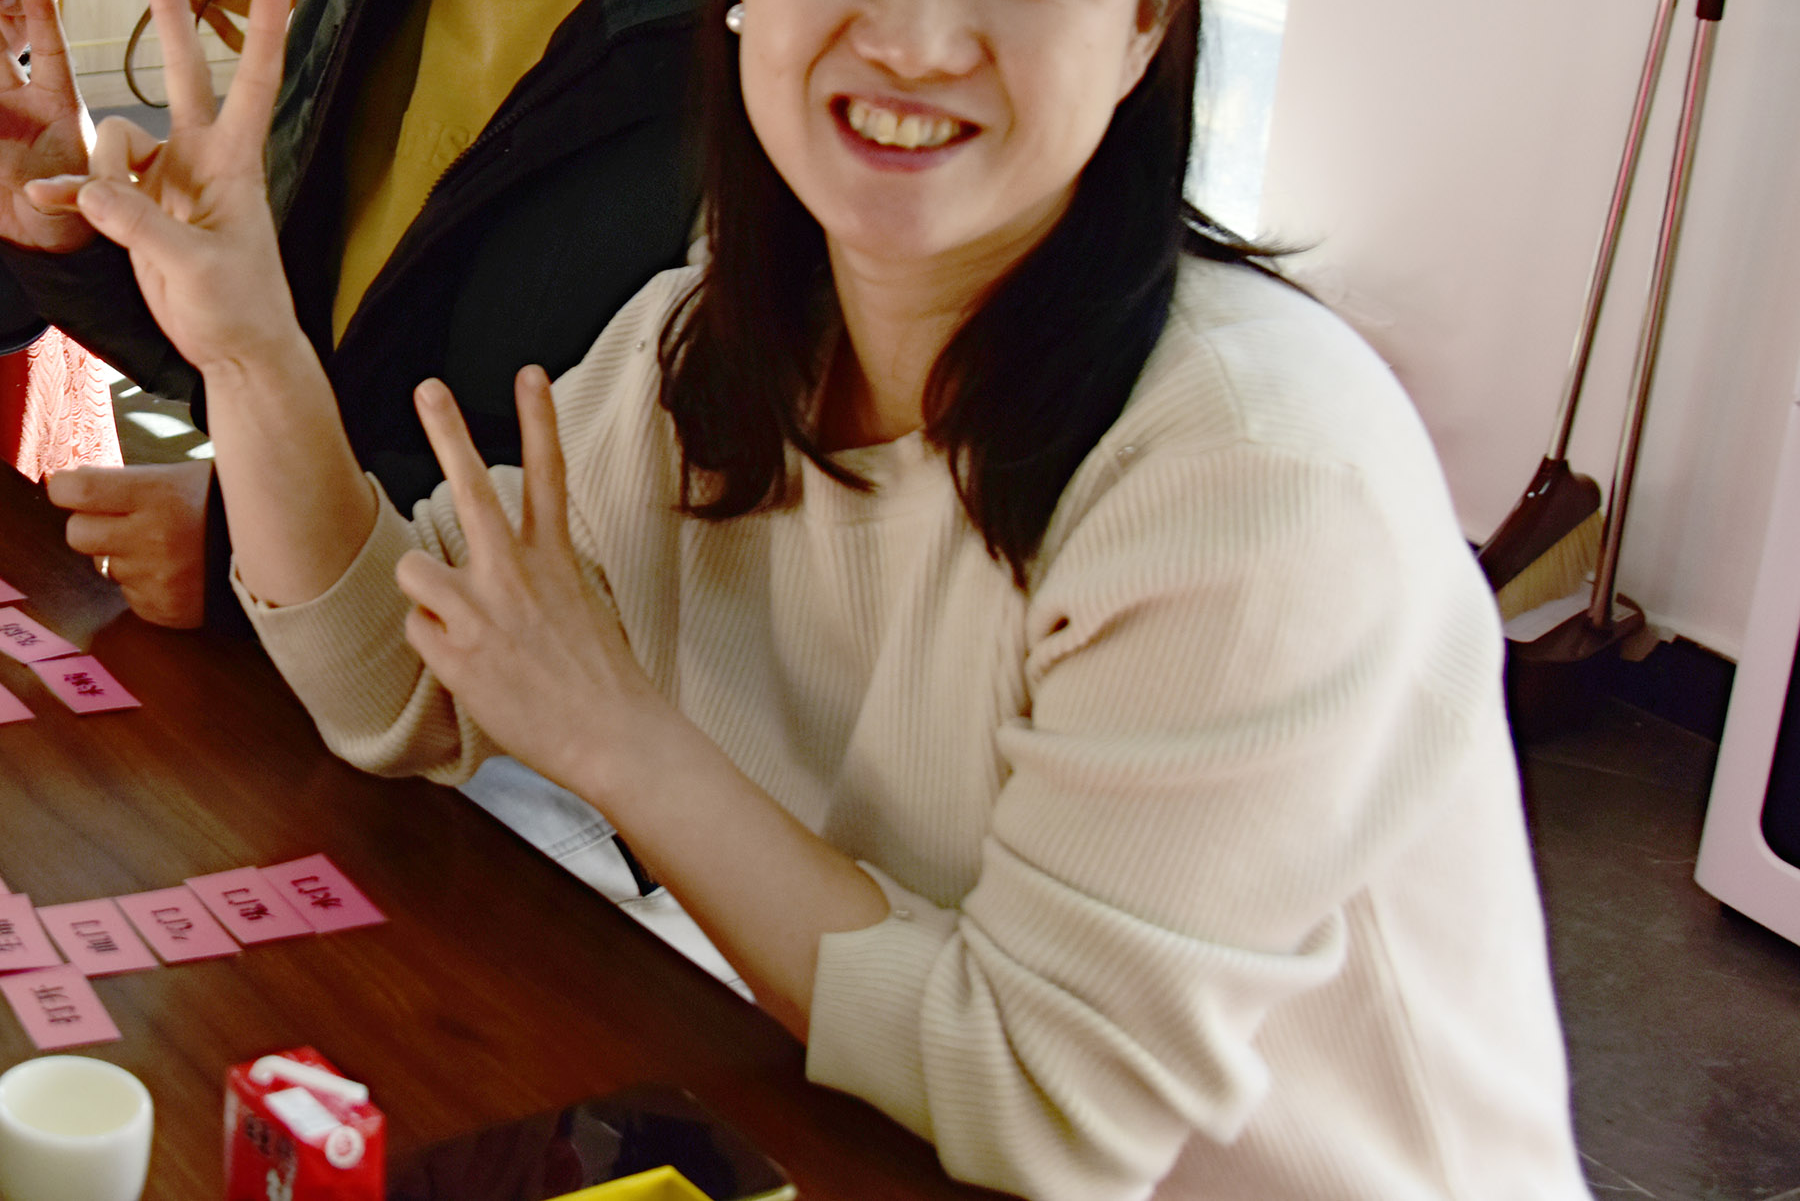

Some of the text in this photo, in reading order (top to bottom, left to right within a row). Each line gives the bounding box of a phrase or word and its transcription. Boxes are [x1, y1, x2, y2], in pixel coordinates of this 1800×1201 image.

[222, 887, 272, 921] 鬼门
[290, 874, 343, 910] 水门
[70, 919, 119, 953] 血门
[151, 906, 194, 940] 气门
[33, 985, 81, 1024] 打开
